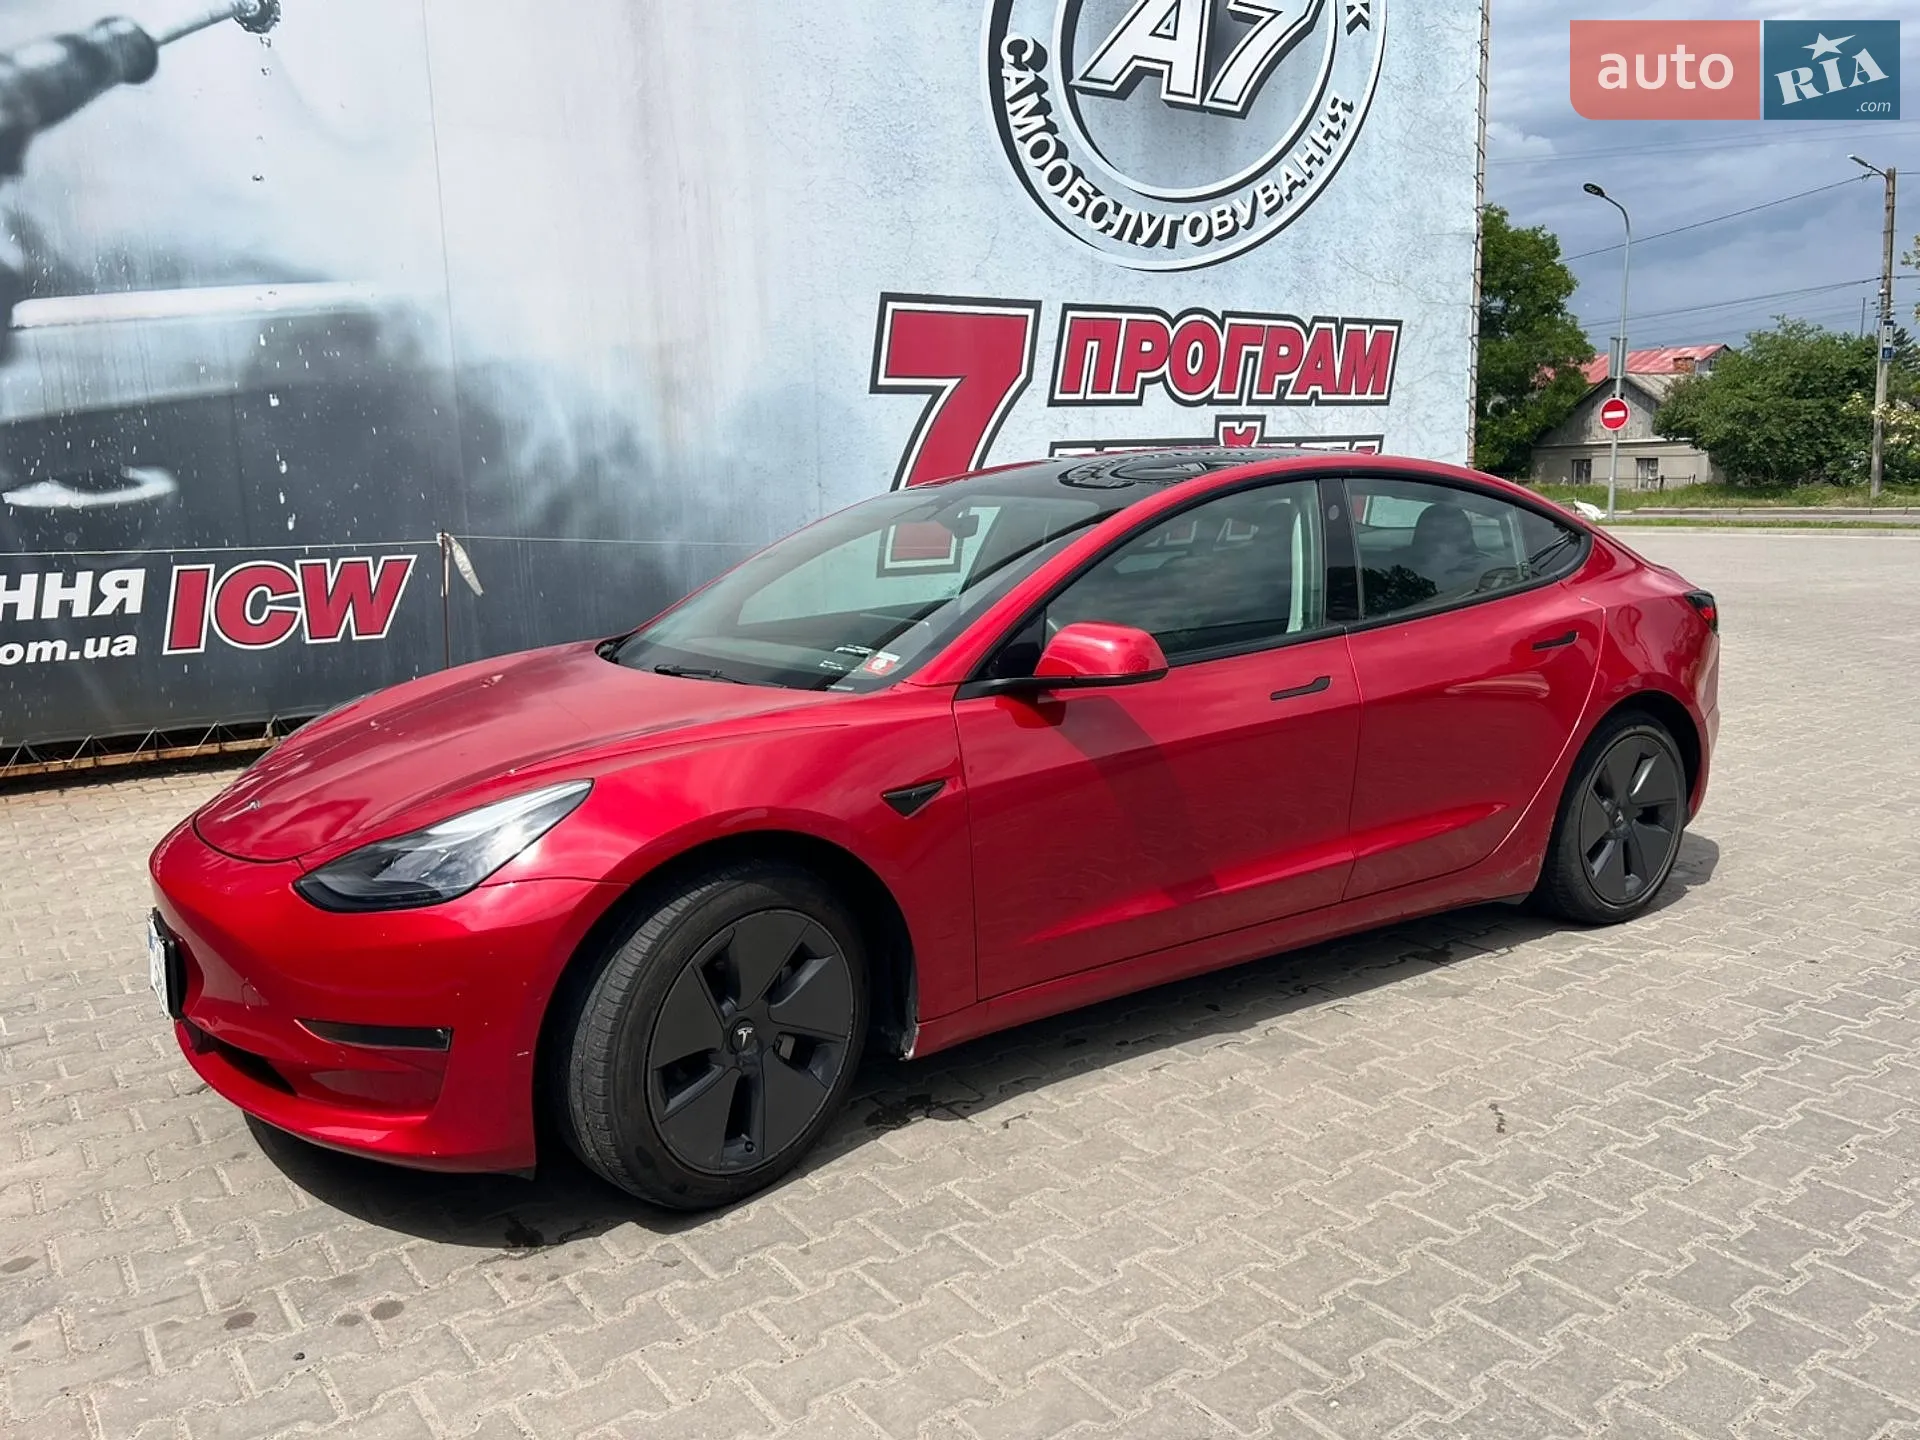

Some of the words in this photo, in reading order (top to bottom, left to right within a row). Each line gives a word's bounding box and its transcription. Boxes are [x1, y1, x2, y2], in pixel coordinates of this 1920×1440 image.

[1000, 33, 1354, 249] САМООБСЛУГОВУВАННЯ
[869, 292, 1042, 577] 7
[1047, 303, 1402, 408] ПРОГРАМ
[0, 568, 146, 621] ННЯ
[163, 555, 418, 655] ICW
[0, 634, 138, 666] om.ua
